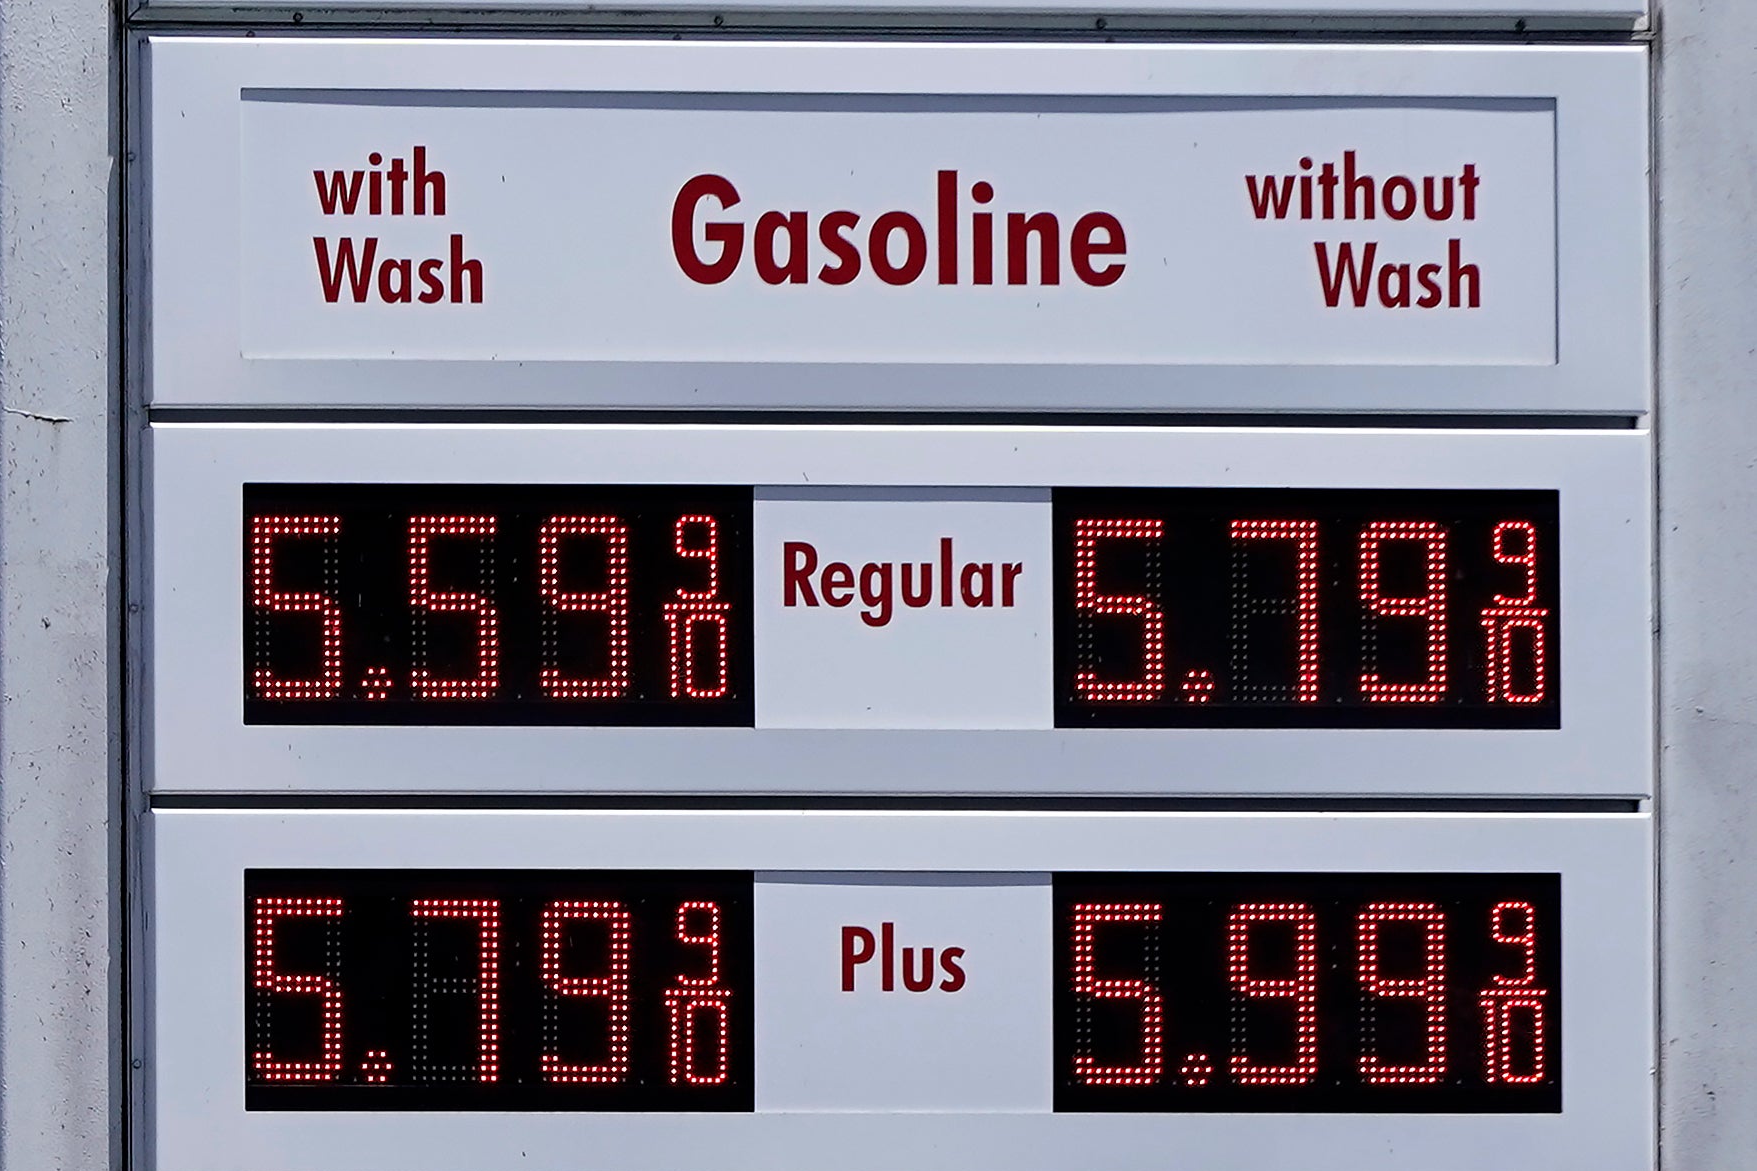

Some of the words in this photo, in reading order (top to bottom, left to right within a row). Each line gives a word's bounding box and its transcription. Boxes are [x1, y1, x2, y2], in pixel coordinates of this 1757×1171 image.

[314, 149, 447, 215] with
[1245, 153, 1479, 221] without
[313, 237, 484, 304] Wash
[670, 173, 1127, 287] Gasoline
[1313, 241, 1480, 309] Wash
[254, 516, 628, 698] 5.59
[783, 540, 1023, 627] Regular
[1076, 519, 1448, 702] 5.79
[256, 898, 630, 1082] 5.79
[841, 925, 966, 992] Plus
[1075, 902, 1447, 1085] 5.99
